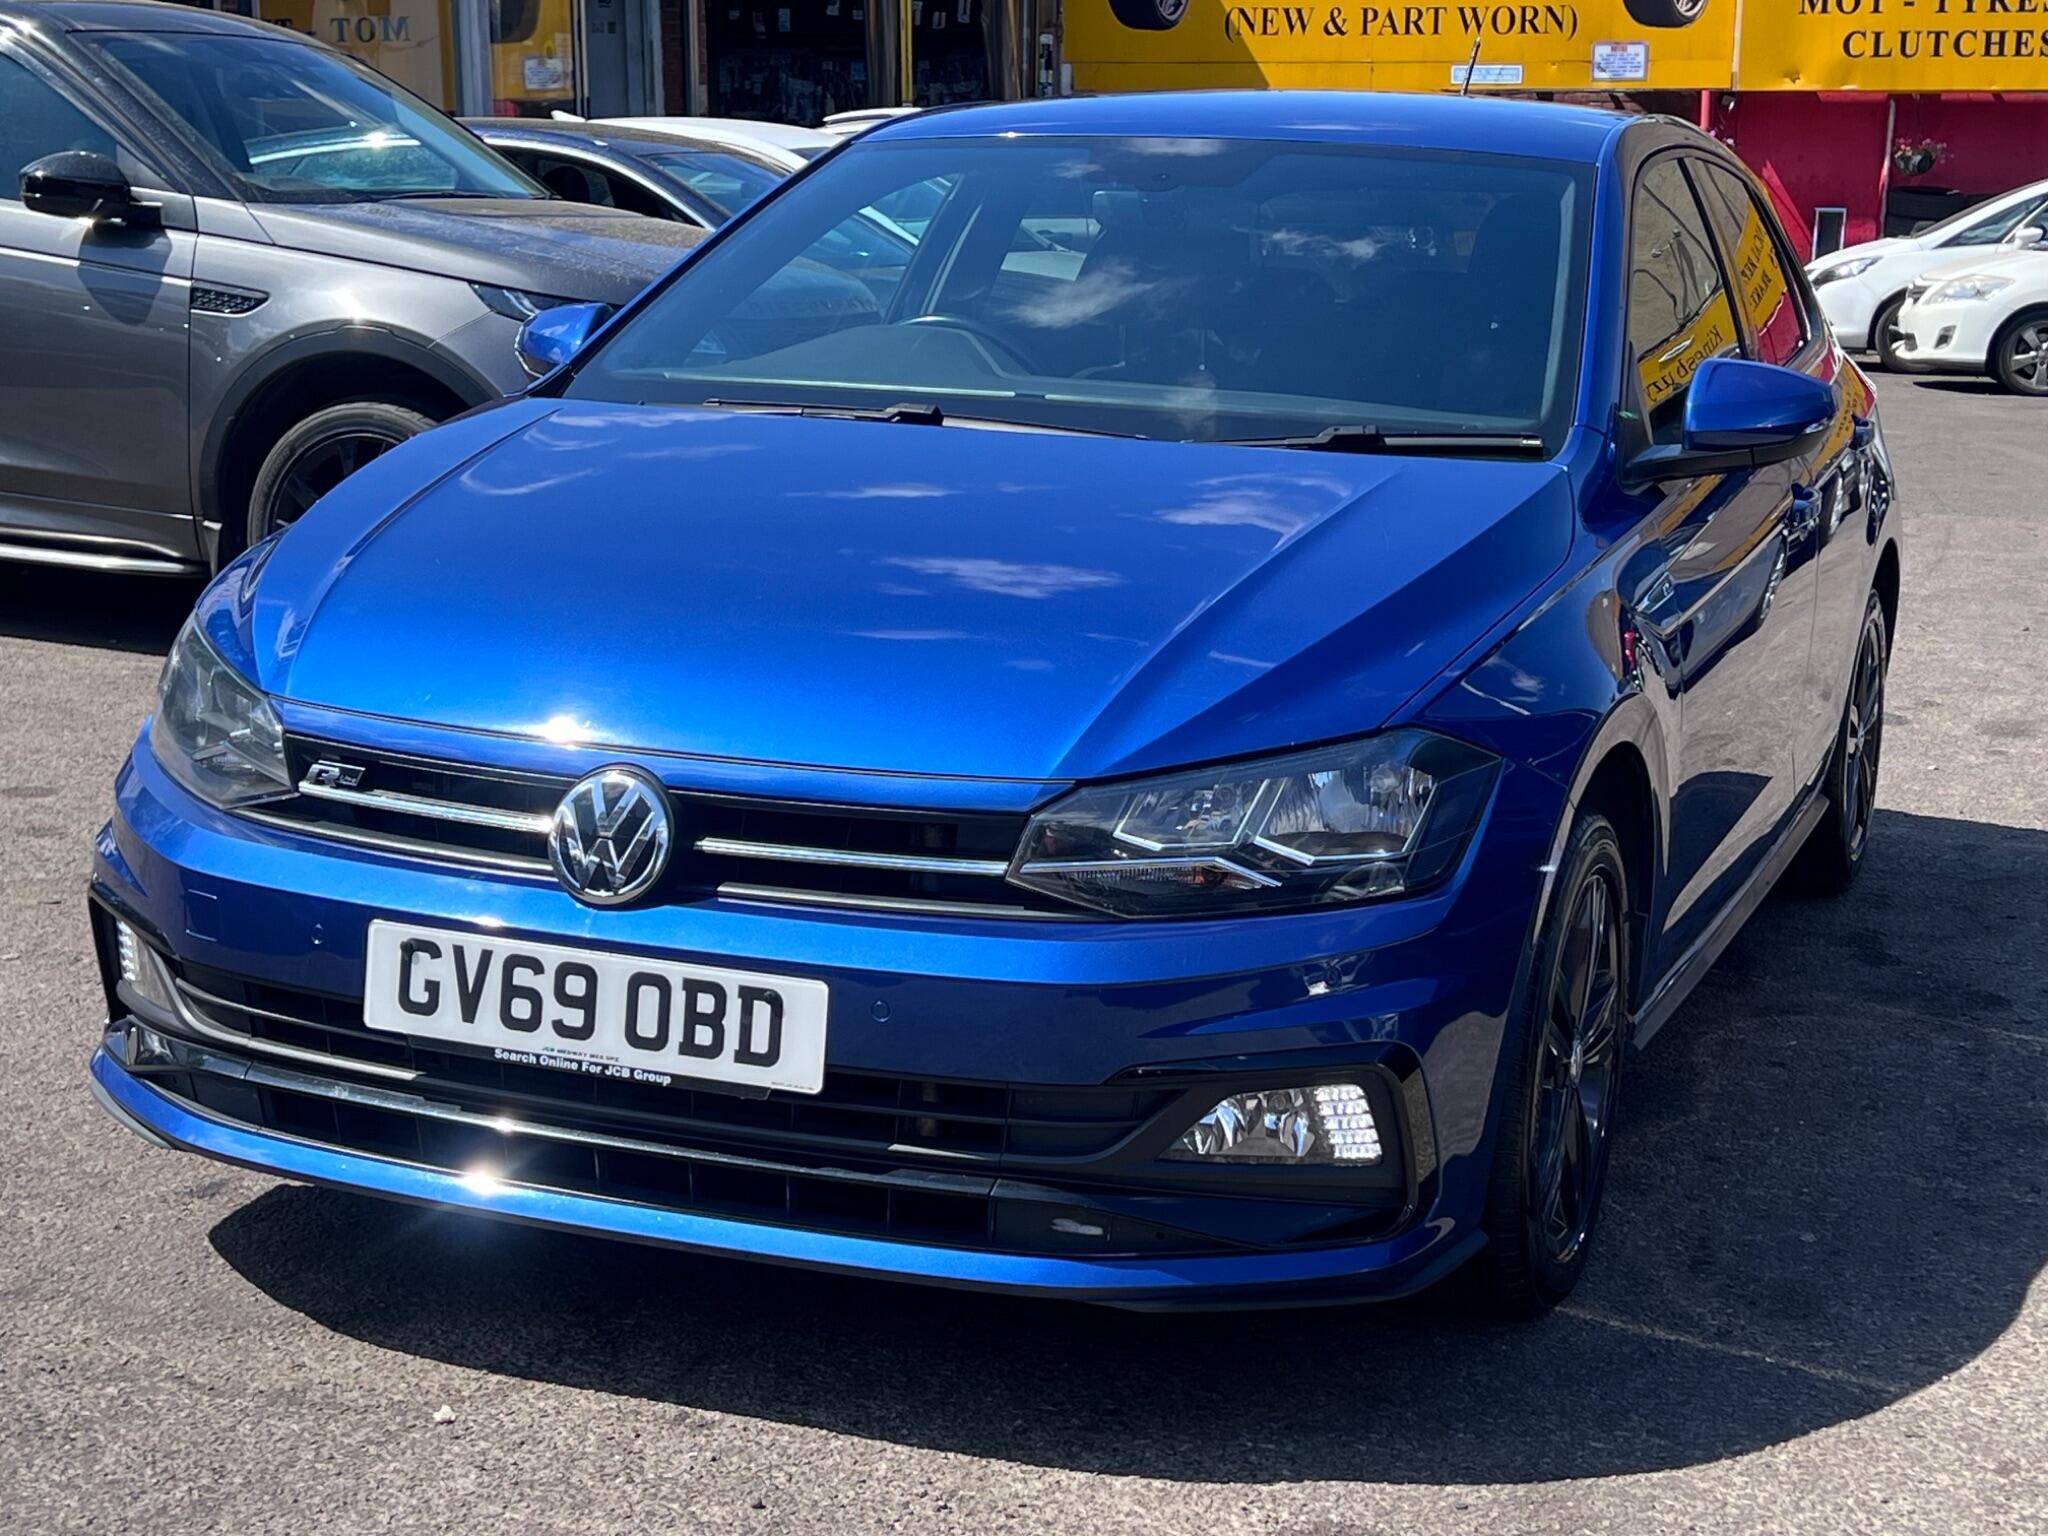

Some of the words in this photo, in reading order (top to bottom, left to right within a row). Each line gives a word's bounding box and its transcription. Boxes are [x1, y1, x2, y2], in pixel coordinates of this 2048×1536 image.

[1224, 6, 1314, 42] (NEW
[1322, 10, 1349, 36] &
[1360, 7, 1448, 36] PART
[1458, 4, 1578, 41] WORN)
[1935, 0, 2048, 14] TYRE
[397, 937, 599, 1041] GV69
[624, 971, 785, 1068] OBD
[494, 1048, 537, 1065] Search
[539, 1056, 579, 1071] Online
[582, 1061, 602, 1074] For
[604, 1065, 631, 1078] JCB
[633, 1070, 672, 1086] Group
